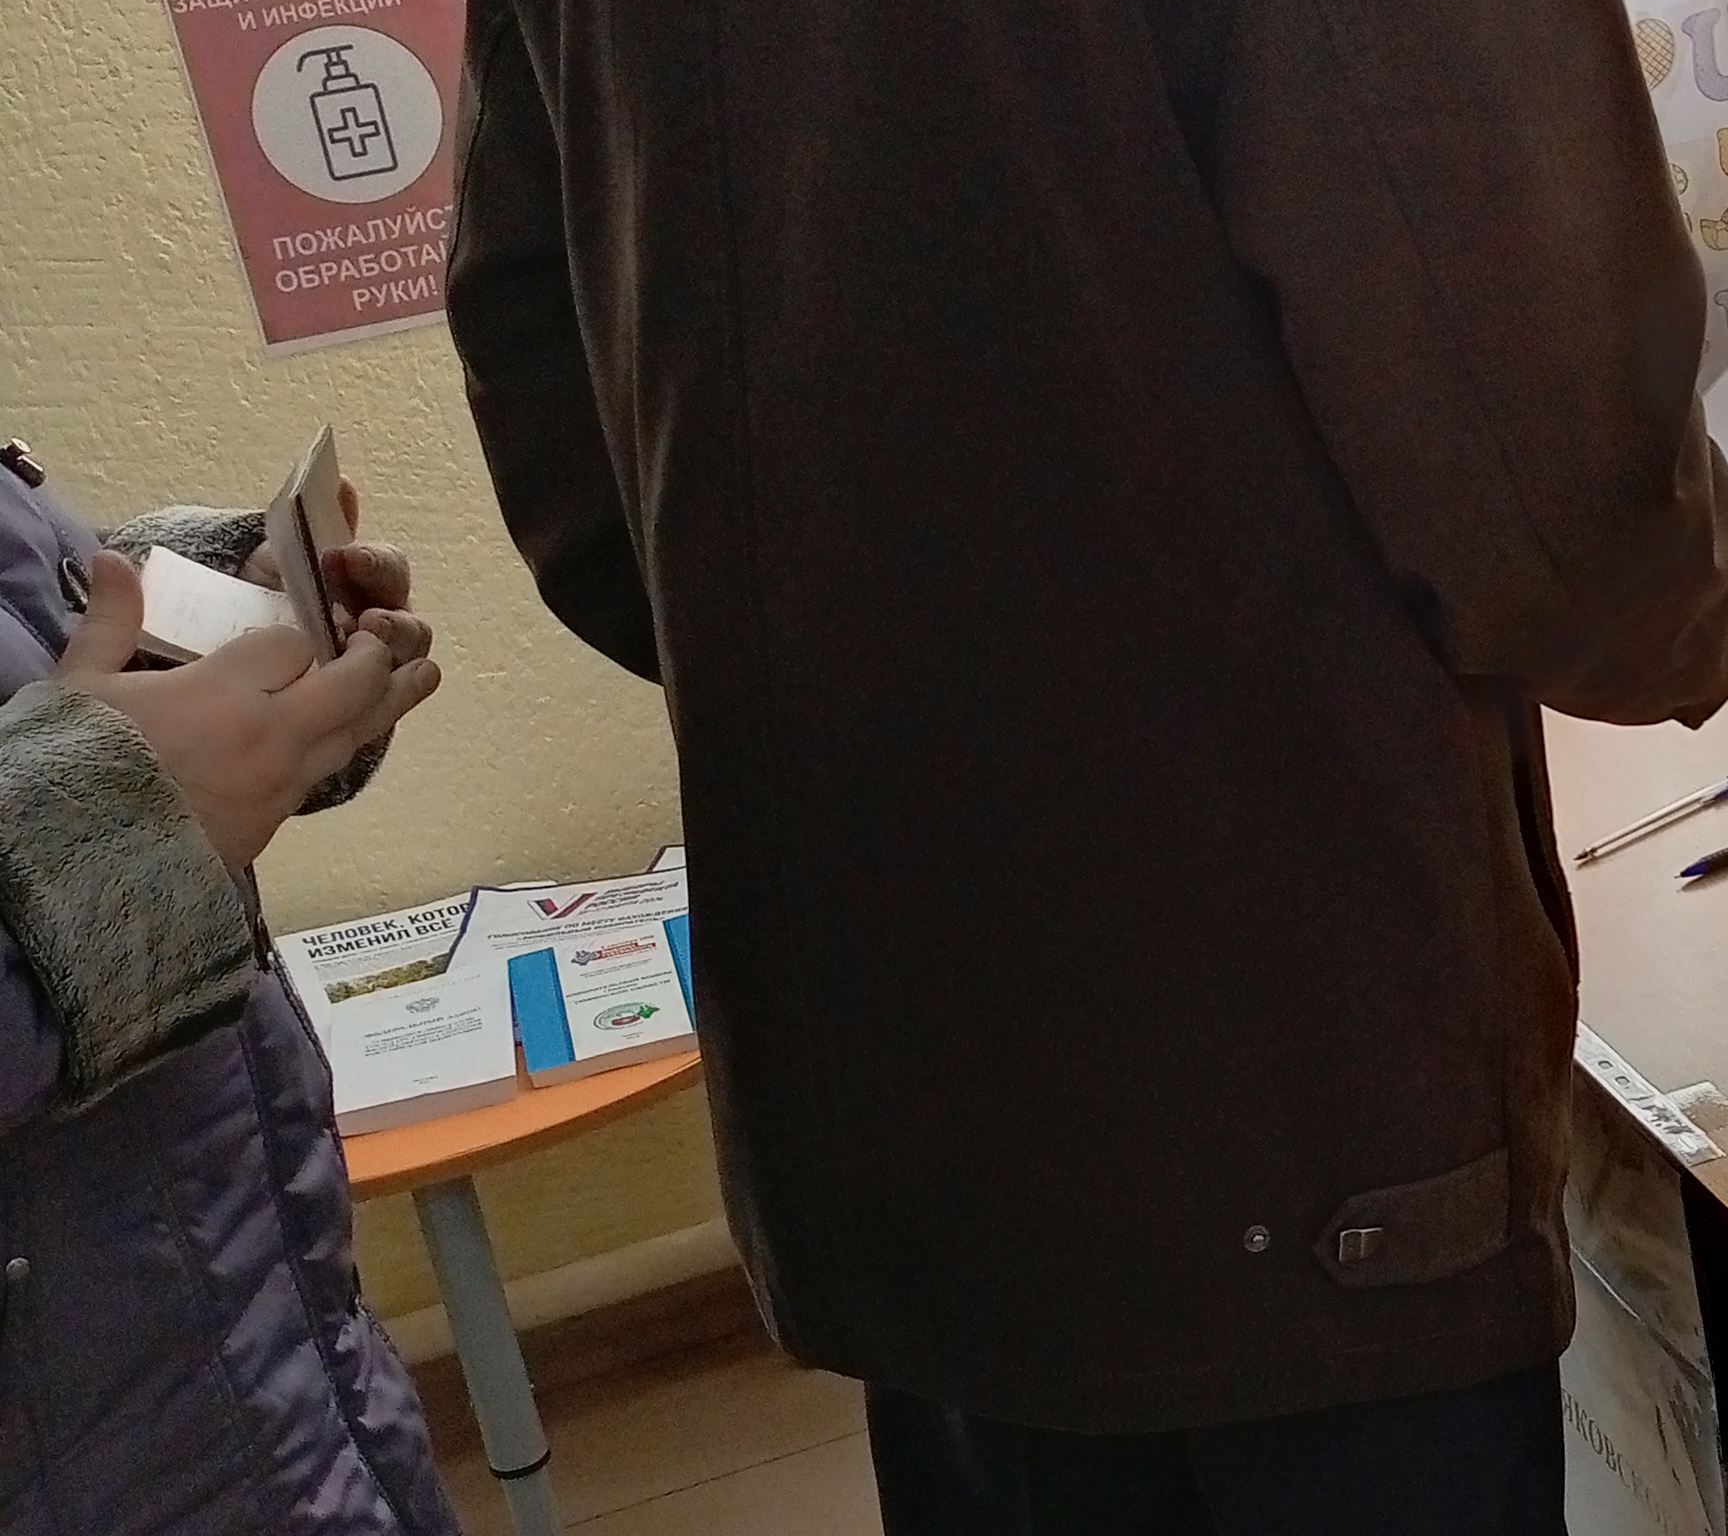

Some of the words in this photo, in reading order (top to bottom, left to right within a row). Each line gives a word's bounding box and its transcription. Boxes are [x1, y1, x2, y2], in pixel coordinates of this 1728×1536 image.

[238, 12, 257, 31] И
[273, 205, 455, 260] ПОЖАЛУЙС
[353, 274, 439, 311] РУКИ!
[408, 902, 471, 925] КОТОР
[307, 927, 411, 959] ИЗМЕНИЛ
